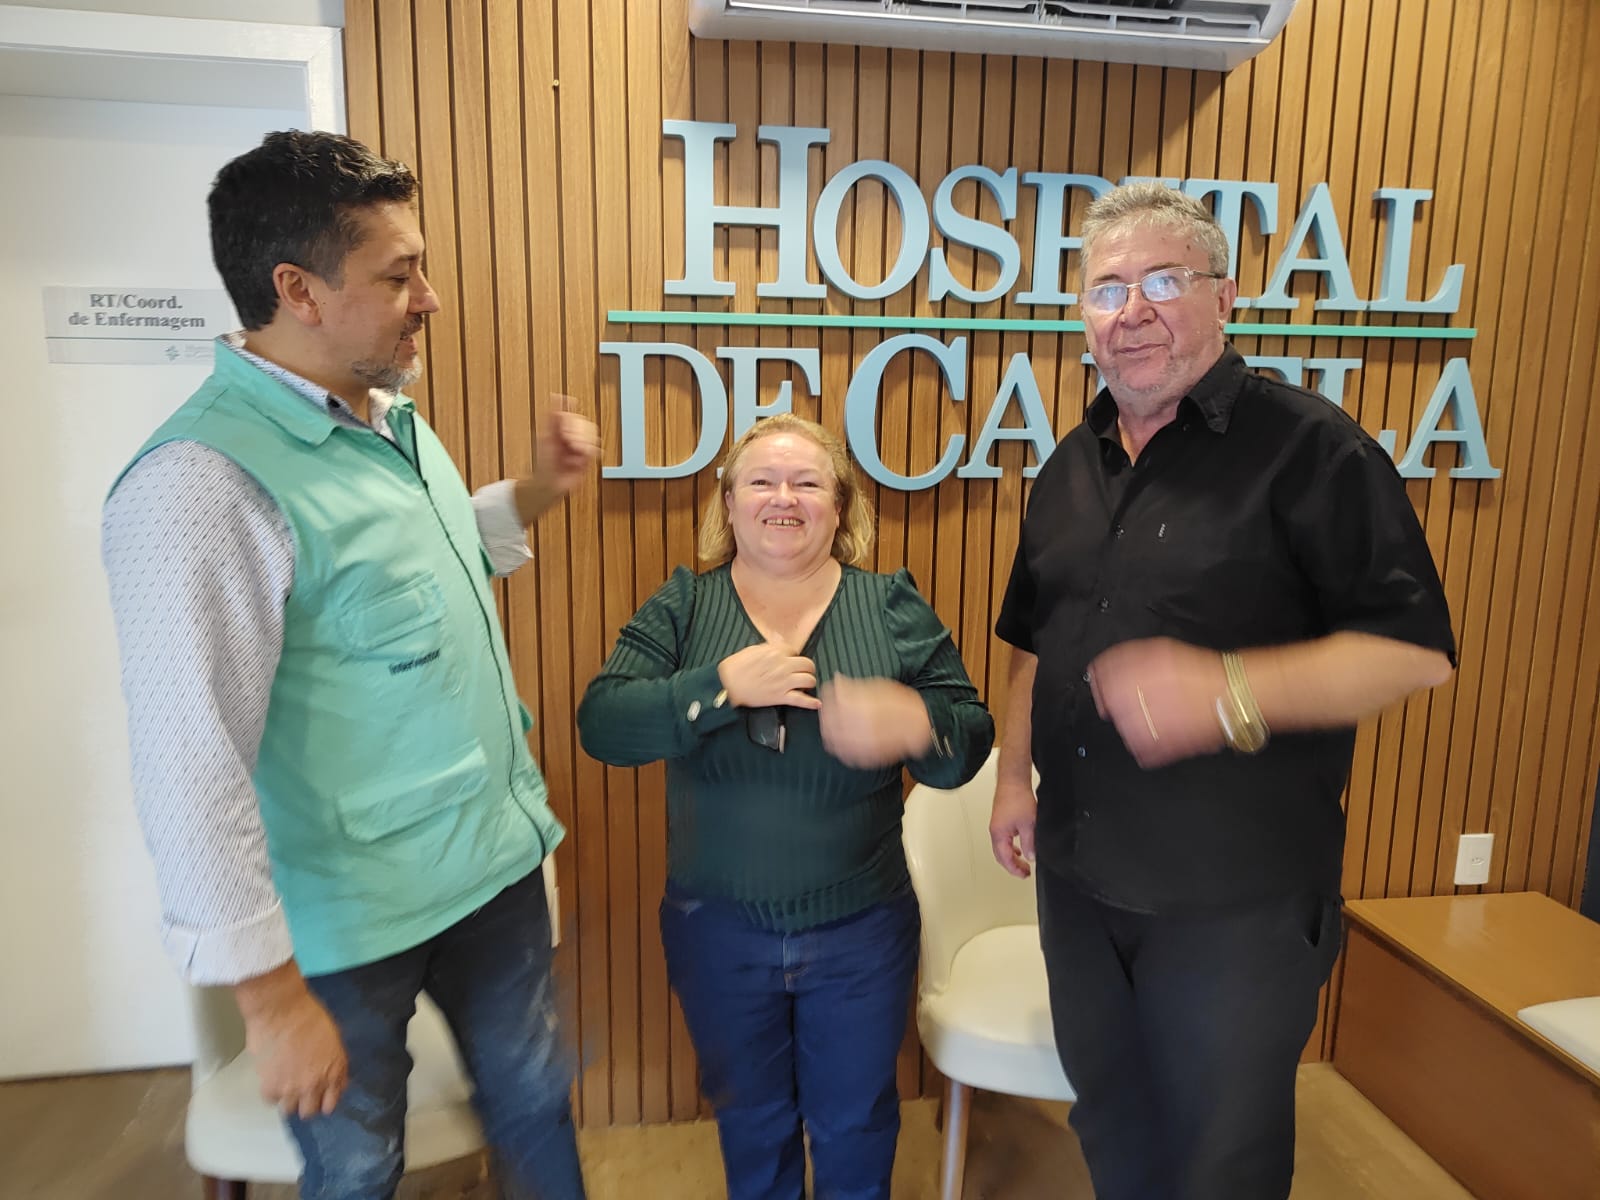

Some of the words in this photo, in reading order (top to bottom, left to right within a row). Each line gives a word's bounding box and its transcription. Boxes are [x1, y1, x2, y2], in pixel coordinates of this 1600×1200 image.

[663, 119, 1465, 313] HOSPTAL
[68, 312, 89, 326] de
[94, 312, 206, 330] Enfermagem
[89, 293, 184, 310] RT/Coord.
[599, 341, 821, 480] DE
[844, 333, 1503, 492] CAA
